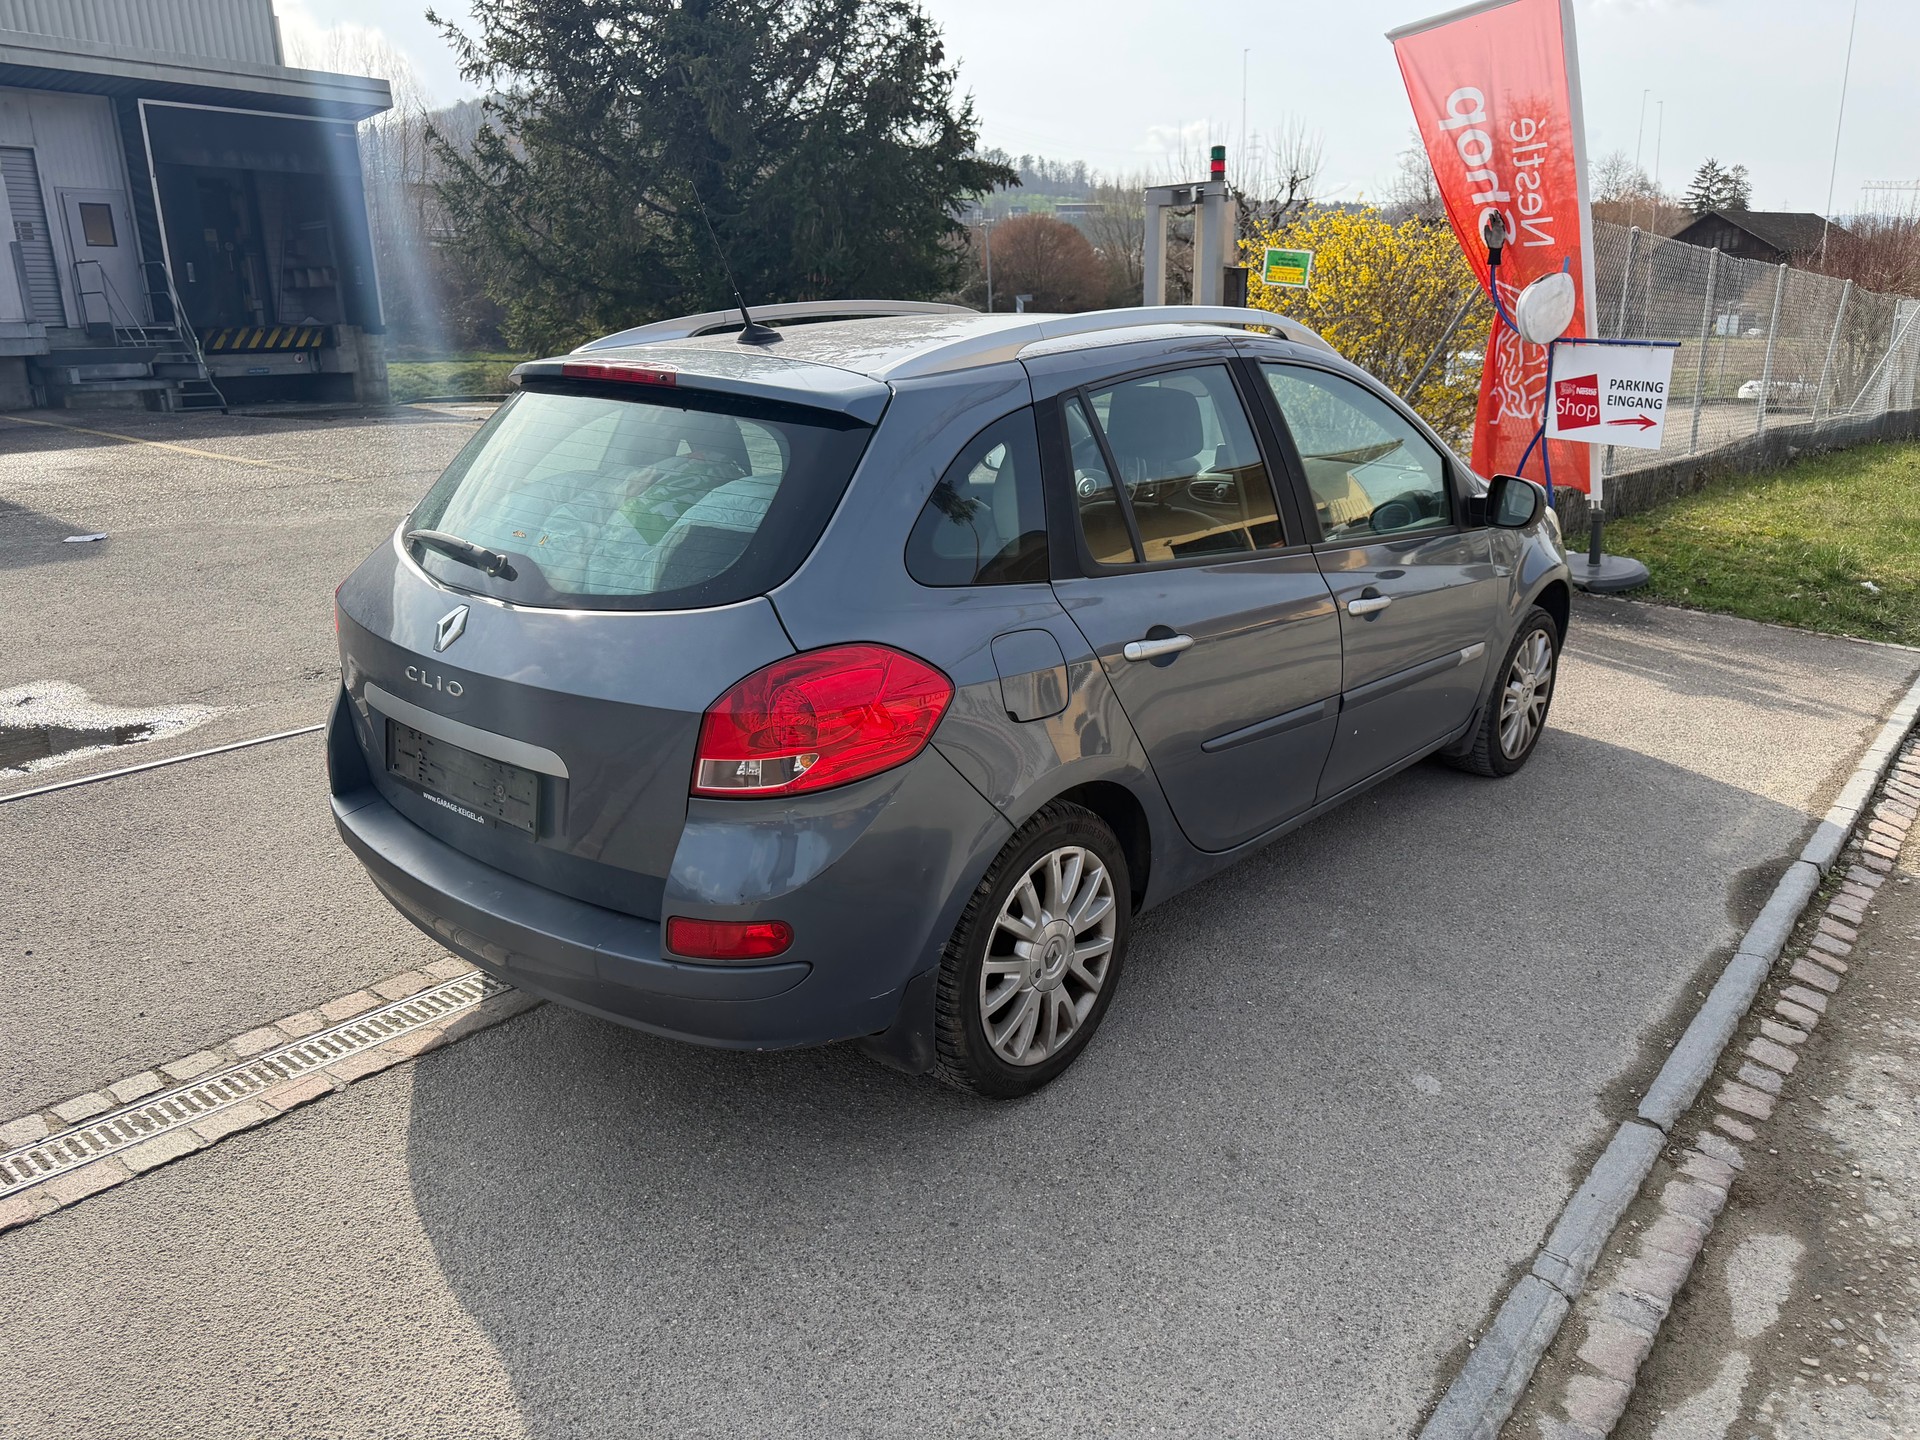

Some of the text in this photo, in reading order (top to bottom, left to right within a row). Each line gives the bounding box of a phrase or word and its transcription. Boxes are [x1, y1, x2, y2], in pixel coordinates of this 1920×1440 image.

[1609, 379, 1664, 393] PARKING
[1556, 398, 1598, 422] Shop
[1607, 395, 1663, 409] EINGANG
[404, 665, 464, 697] CLIO
